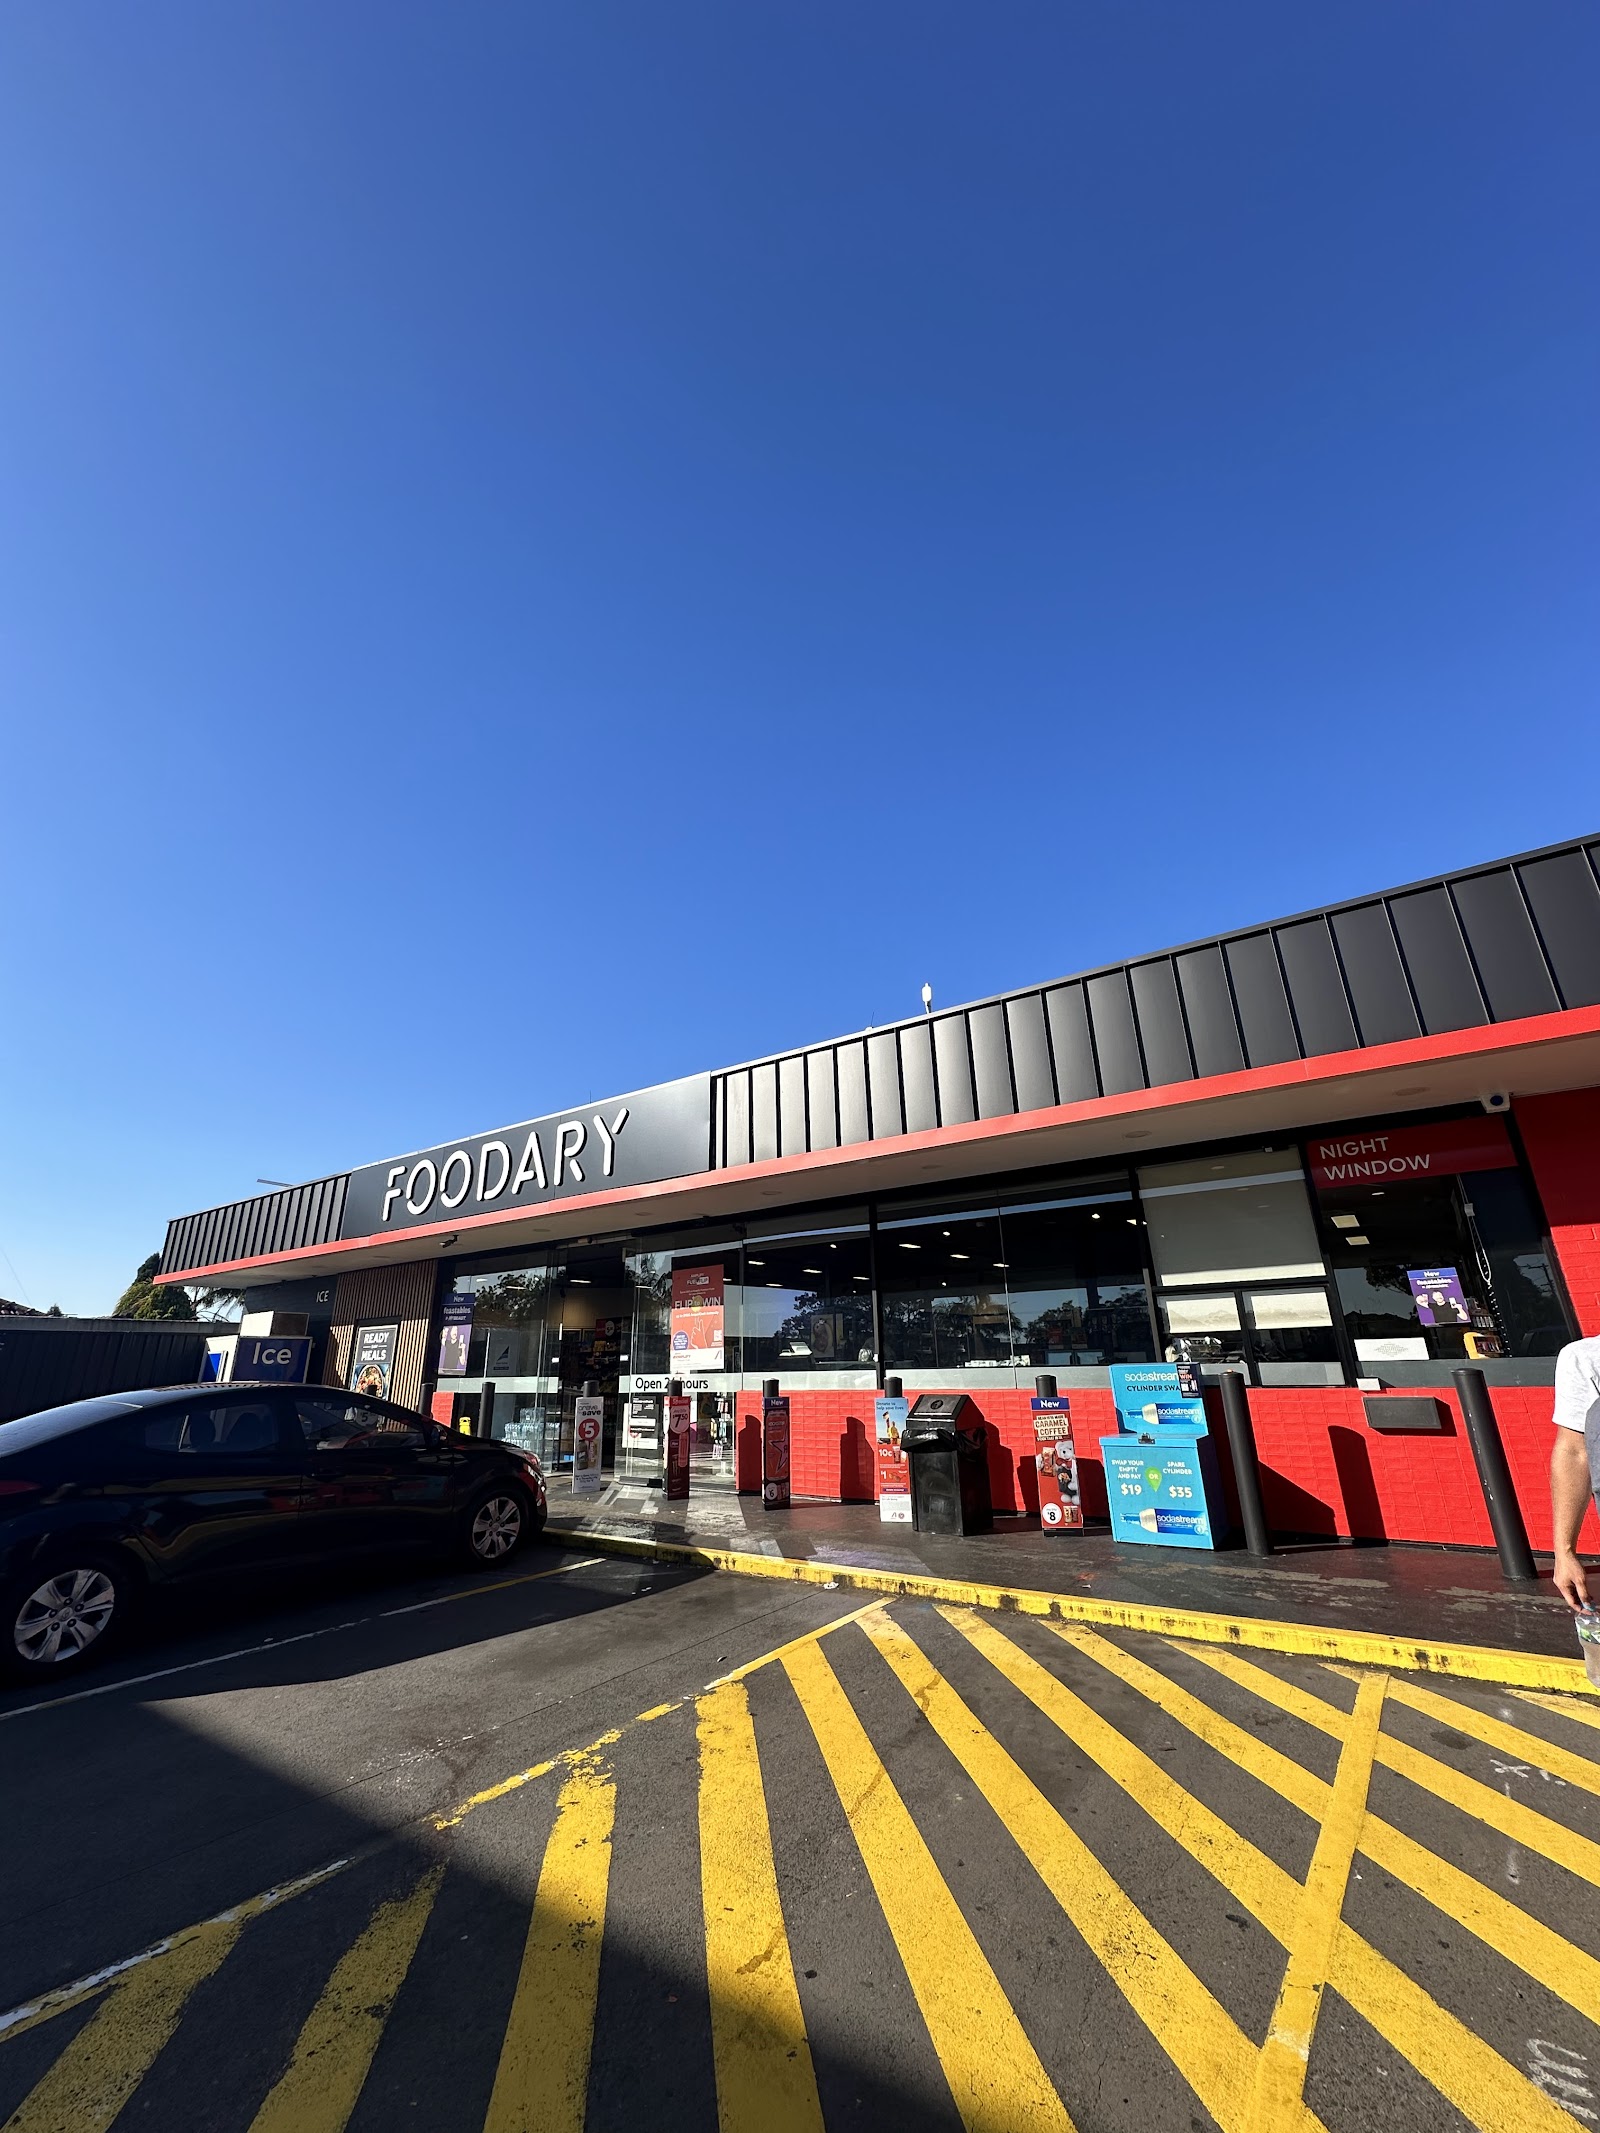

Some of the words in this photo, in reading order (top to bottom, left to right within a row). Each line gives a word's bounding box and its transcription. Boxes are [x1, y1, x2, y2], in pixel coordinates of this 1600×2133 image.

[1320, 1137, 1389, 1160] NIGHT
[382, 1108, 628, 1222] FOODARY
[1323, 1154, 1430, 1180] WINDOW
[316, 1290, 330, 1303] ICE
[675, 1299, 693, 1310] FLIP
[703, 1296, 721, 1306] WIN
[364, 1332, 389, 1344] READY
[252, 1342, 292, 1365] Ice
[361, 1350, 387, 1361] MEALS
[635, 1377, 662, 1391] Open
[1040, 1400, 1060, 1408] New
[1035, 1419, 1067, 1428] CARAMEL
[1039, 1427, 1067, 1435] COFFEE
[879, 1448, 893, 1457] 10c
[1120, 1483, 1142, 1496] $19
[1168, 1485, 1193, 1498] $35
